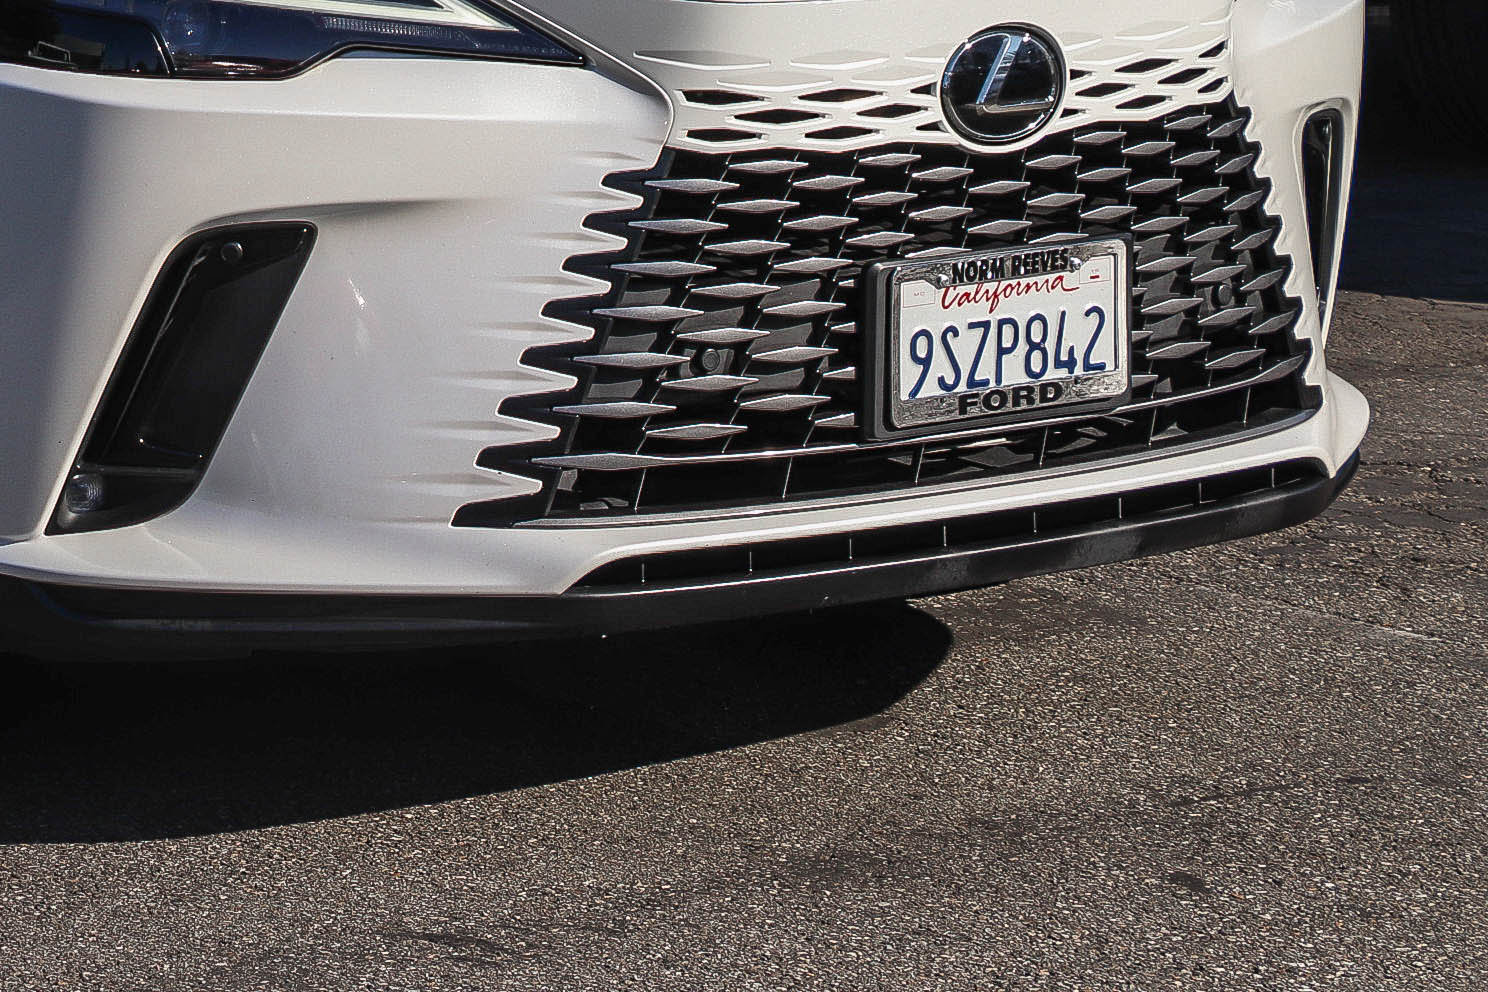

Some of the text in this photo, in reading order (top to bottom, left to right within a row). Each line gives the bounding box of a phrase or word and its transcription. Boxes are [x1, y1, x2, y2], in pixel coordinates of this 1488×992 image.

[952, 248, 1070, 284] NORM REEVES
[940, 274, 1079, 314] California
[908, 305, 1107, 399] 9SZP842
[958, 381, 1064, 415] FORD
